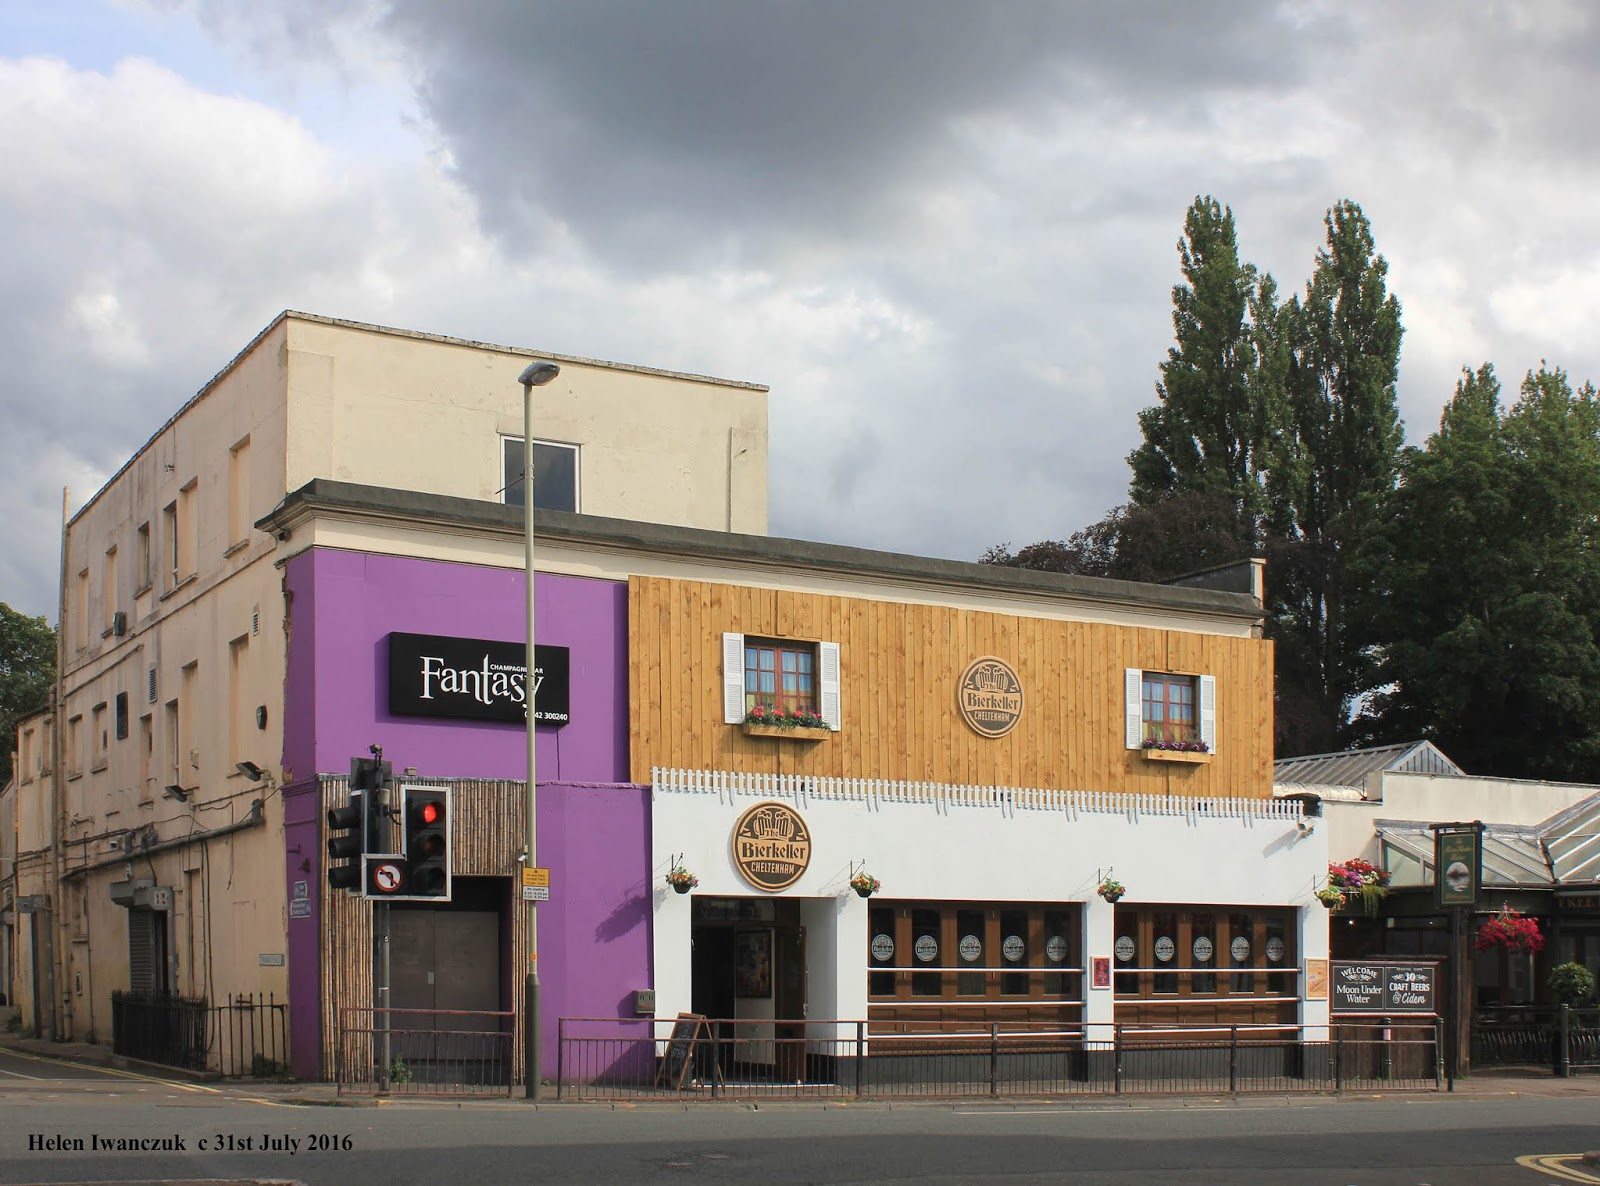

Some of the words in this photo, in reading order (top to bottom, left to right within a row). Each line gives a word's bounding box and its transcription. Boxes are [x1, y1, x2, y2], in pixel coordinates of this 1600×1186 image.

[967, 693, 1018, 710] Bierkeller
[544, 712, 568, 720] 300240
[974, 711, 1010, 721] CHELTENHAM
[741, 842, 805, 859] Bierkeller
[751, 862, 794, 874] CHELTENHAM
[1340, 966, 1378, 979] WELCOME
[1404, 972, 1416, 981] 30
[1336, 984, 1360, 994] Moon
[1361, 984, 1382, 994] Under
[1388, 982, 1409, 991] CRAFT
[1410, 982, 1430, 991] BEERS
[1346, 993, 1371, 1004] Water
[1401, 992, 1426, 1004] Ciders
